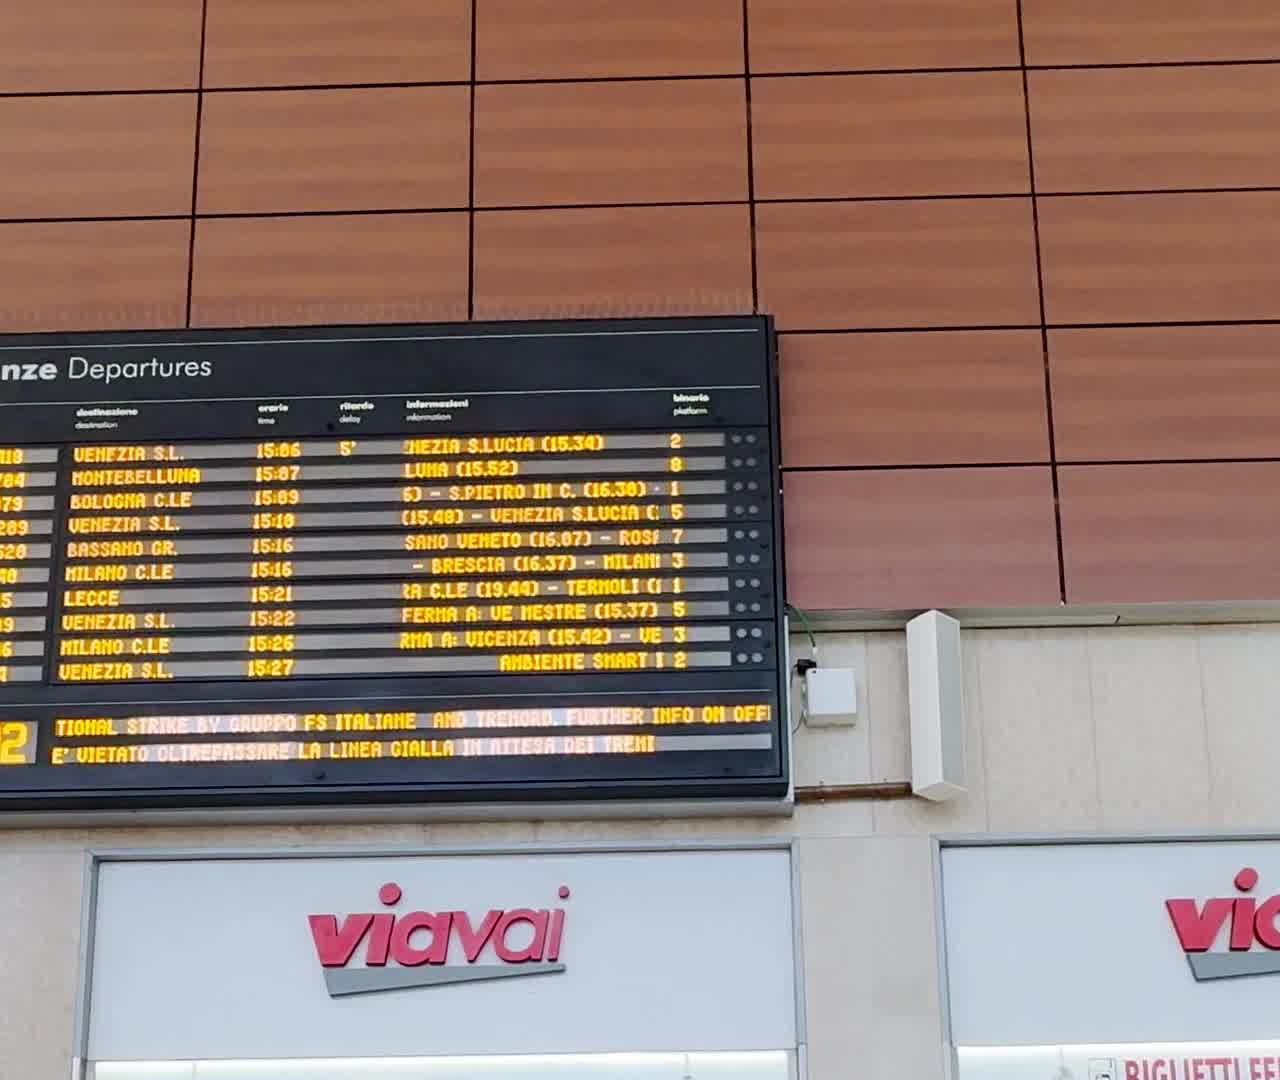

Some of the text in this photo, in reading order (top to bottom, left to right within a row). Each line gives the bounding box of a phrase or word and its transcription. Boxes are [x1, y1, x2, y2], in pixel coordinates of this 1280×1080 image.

[68, 356, 212, 384] Departures
[405, 412, 452, 422] information
[673, 406, 709, 417] platform
[406, 399, 469, 409] informazioni
[73, 446, 146, 463] VENEZIA
[153, 445, 185, 461] S.L.
[256, 442, 301, 459] 15:06
[468, 436, 535, 454] S.LUCIA
[670, 433, 682, 449] 2
[72, 467, 201, 487] MONTEBELLUNA
[255, 466, 301, 483] 15:07
[456, 460, 520, 478] (15.52)
[670, 457, 683, 473] 8
[70, 492, 147, 510] BOLOGNA
[153, 491, 193, 508] C.LE
[254, 489, 300, 506] 15:09
[449, 484, 526, 501] S.PIETRO
[533, 483, 552, 500] IN
[559, 482, 577, 499] C.
[670, 480, 680, 497] 1
[68, 517, 141, 534] VENEZIA
[148, 515, 180, 531] S.L.
[490, 507, 564, 523] VENEZIA
[572, 505, 640, 522] S.LUCIA
[671, 503, 683, 520] 5
[66, 541, 144, 559] BASSANO
[151, 540, 179, 556] GR.
[252, 537, 294, 555] 15:16
[404, 534, 449, 551] SANO
[456, 533, 522, 550] VENETO
[671, 528, 684, 545] 7
[65, 565, 127, 582] MILANO
[135, 564, 174, 581] C.LE
[251, 561, 293, 579] 15:16
[431, 557, 506, 574] BRESCIA
[513, 555, 577, 573] (16.37)
[672, 552, 684, 569] 3
[63, 590, 120, 607] LECCE
[250, 586, 293, 603] 15:21
[429, 582, 468, 599] C.LE
[567, 578, 639, 595] TERMOLI
[672, 577, 682, 594] 1
[61, 613, 136, 630] VENEZIA
[144, 612, 176, 629] S.L.
[249, 610, 296, 627] 15:22
[401, 606, 458, 624] FERMA
[490, 605, 513, 621] VE
[520, 603, 587, 621] MESTRE
[594, 602, 659, 619] (15.37)
[672, 601, 686, 618] 5
[60, 638, 124, 656] MILANO
[132, 637, 170, 654] C.LE
[248, 635, 295, 652] 15:26
[465, 629, 541, 647] VICENZA
[548, 627, 612, 645] (15.42)
[673, 626, 687, 643] 3
[59, 663, 133, 681] VENEZIA
[141, 662, 174, 679] S.L.
[246, 659, 295, 677] 15:27
[499, 654, 585, 671] AMBIENTE
[592, 652, 648, 669] SMART
[674, 651, 688, 668] 2
[304, 713, 328, 731] FS
[335, 712, 417, 730] ITALIANE
[432, 711, 466, 729] AND
[654, 706, 695, 724] INFO
[702, 706, 726, 723] ON
[76, 744, 147, 763] VIETATO
[298, 742, 322, 760] LA
[330, 740, 383, 759] LINEA
[390, 739, 455, 758] GIALLA
[306, 882, 572, 968] viavai
